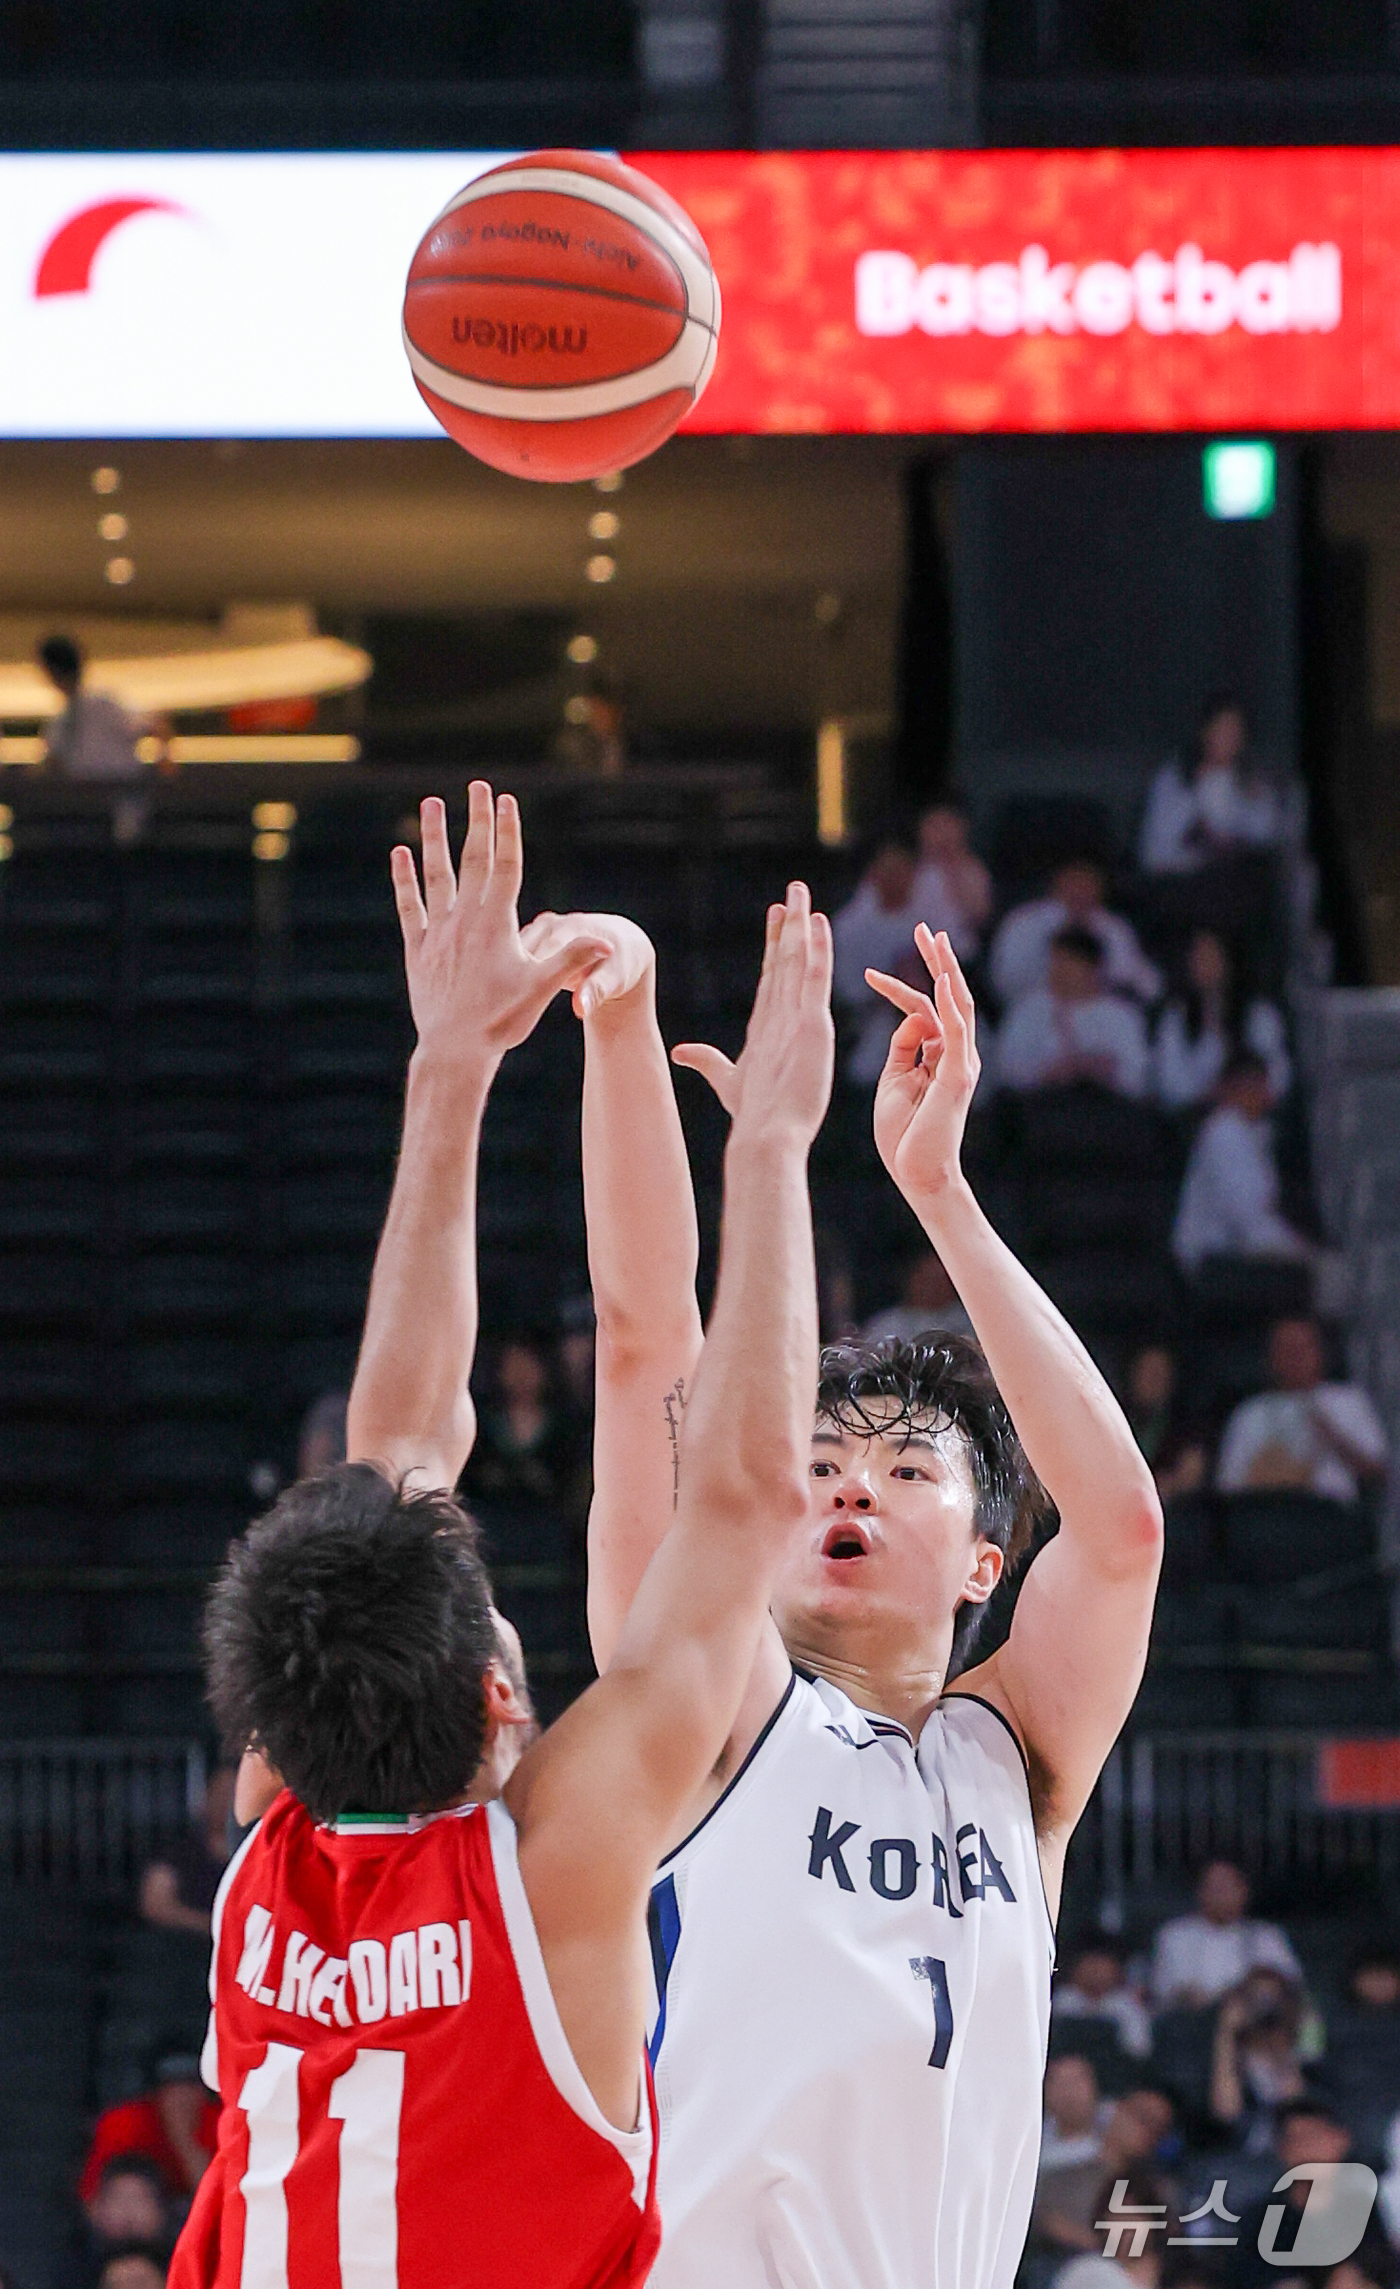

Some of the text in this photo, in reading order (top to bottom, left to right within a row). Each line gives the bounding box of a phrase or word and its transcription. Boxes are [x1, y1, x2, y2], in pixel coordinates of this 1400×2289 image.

[452, 316, 588, 356] molten
[855, 242, 1342, 336] Basketball
[808, 1806, 1017, 1918] KOREA
[909, 1956, 954, 2069] 1
[238, 2042, 406, 2289] 11
